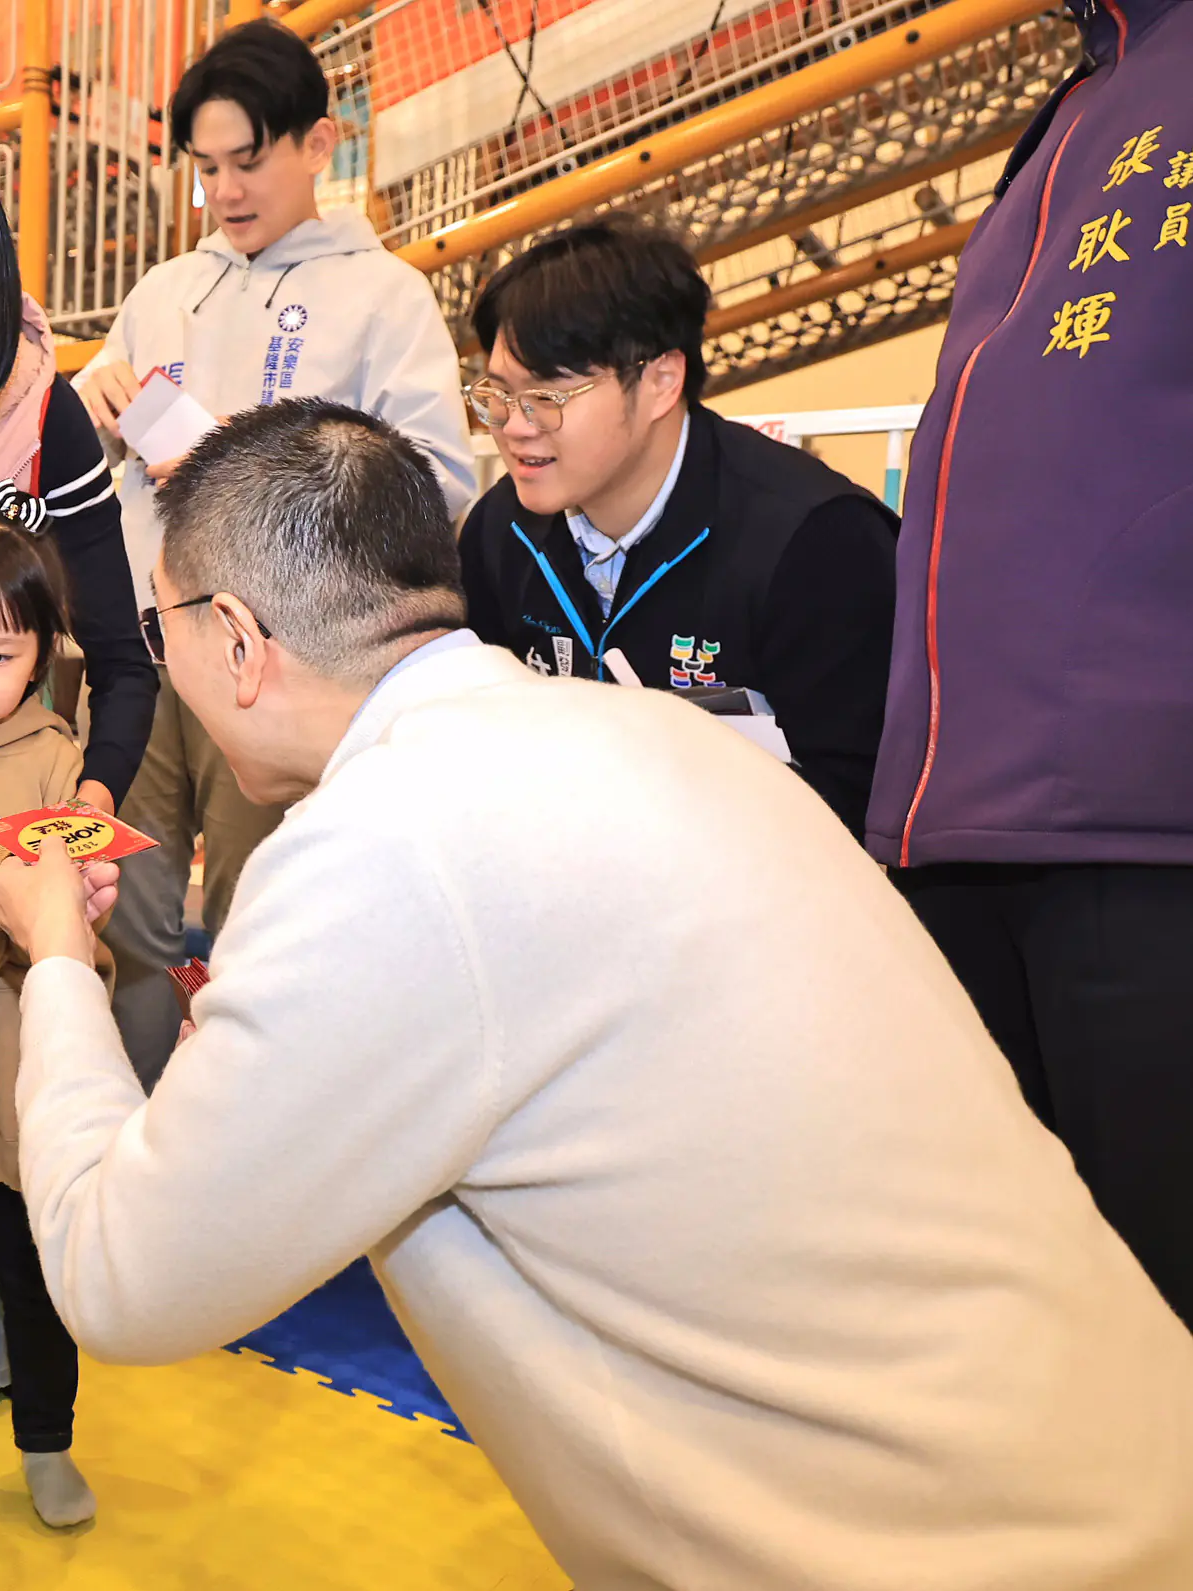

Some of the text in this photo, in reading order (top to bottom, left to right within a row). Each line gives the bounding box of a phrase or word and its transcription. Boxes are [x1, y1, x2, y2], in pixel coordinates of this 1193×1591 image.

[1042, 125, 1164, 359] 張耿輝
[279, 336, 305, 389] 安樂區
[69, 841, 99, 854] 2026
